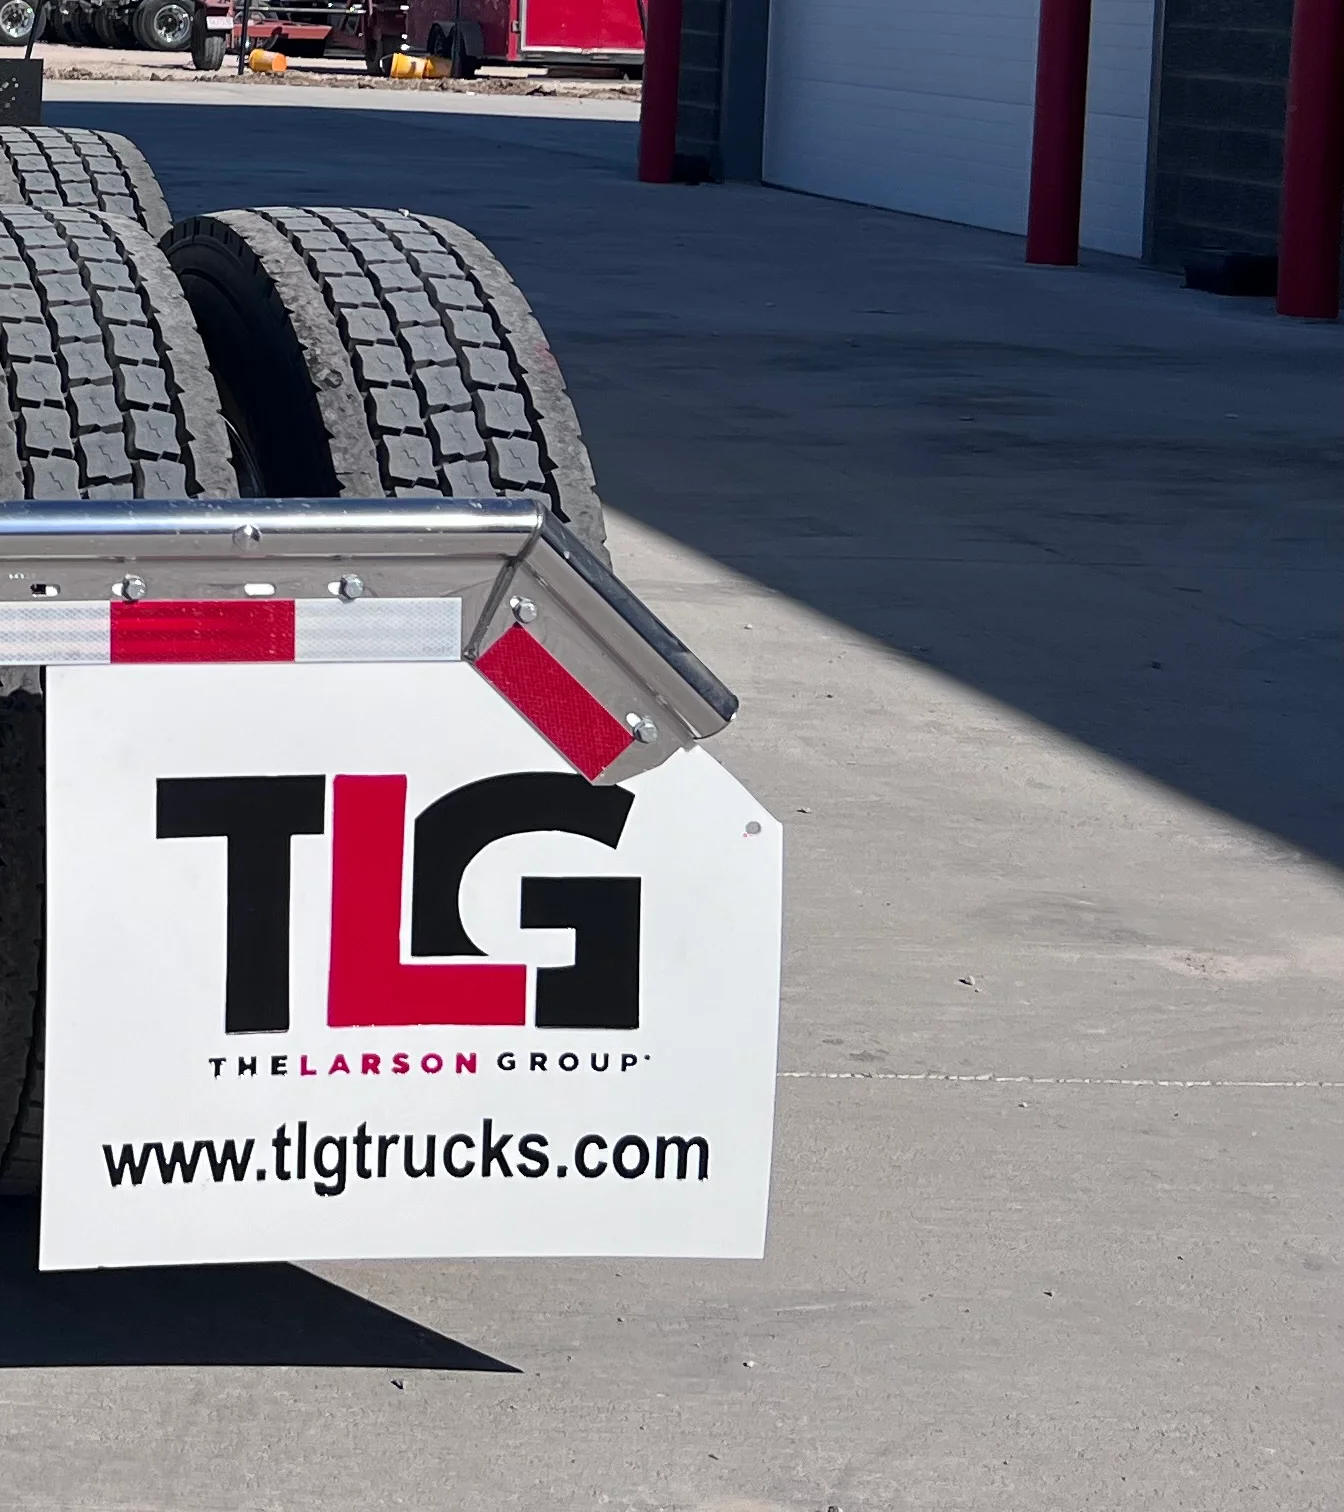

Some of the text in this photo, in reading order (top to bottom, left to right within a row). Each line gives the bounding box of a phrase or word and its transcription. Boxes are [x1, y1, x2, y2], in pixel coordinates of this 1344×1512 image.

[156, 771, 642, 1035] TLG
[209, 1051, 638, 1078] THE LARSON GROUP
[102, 1118, 709, 1197] www.tlgtrucks.com
